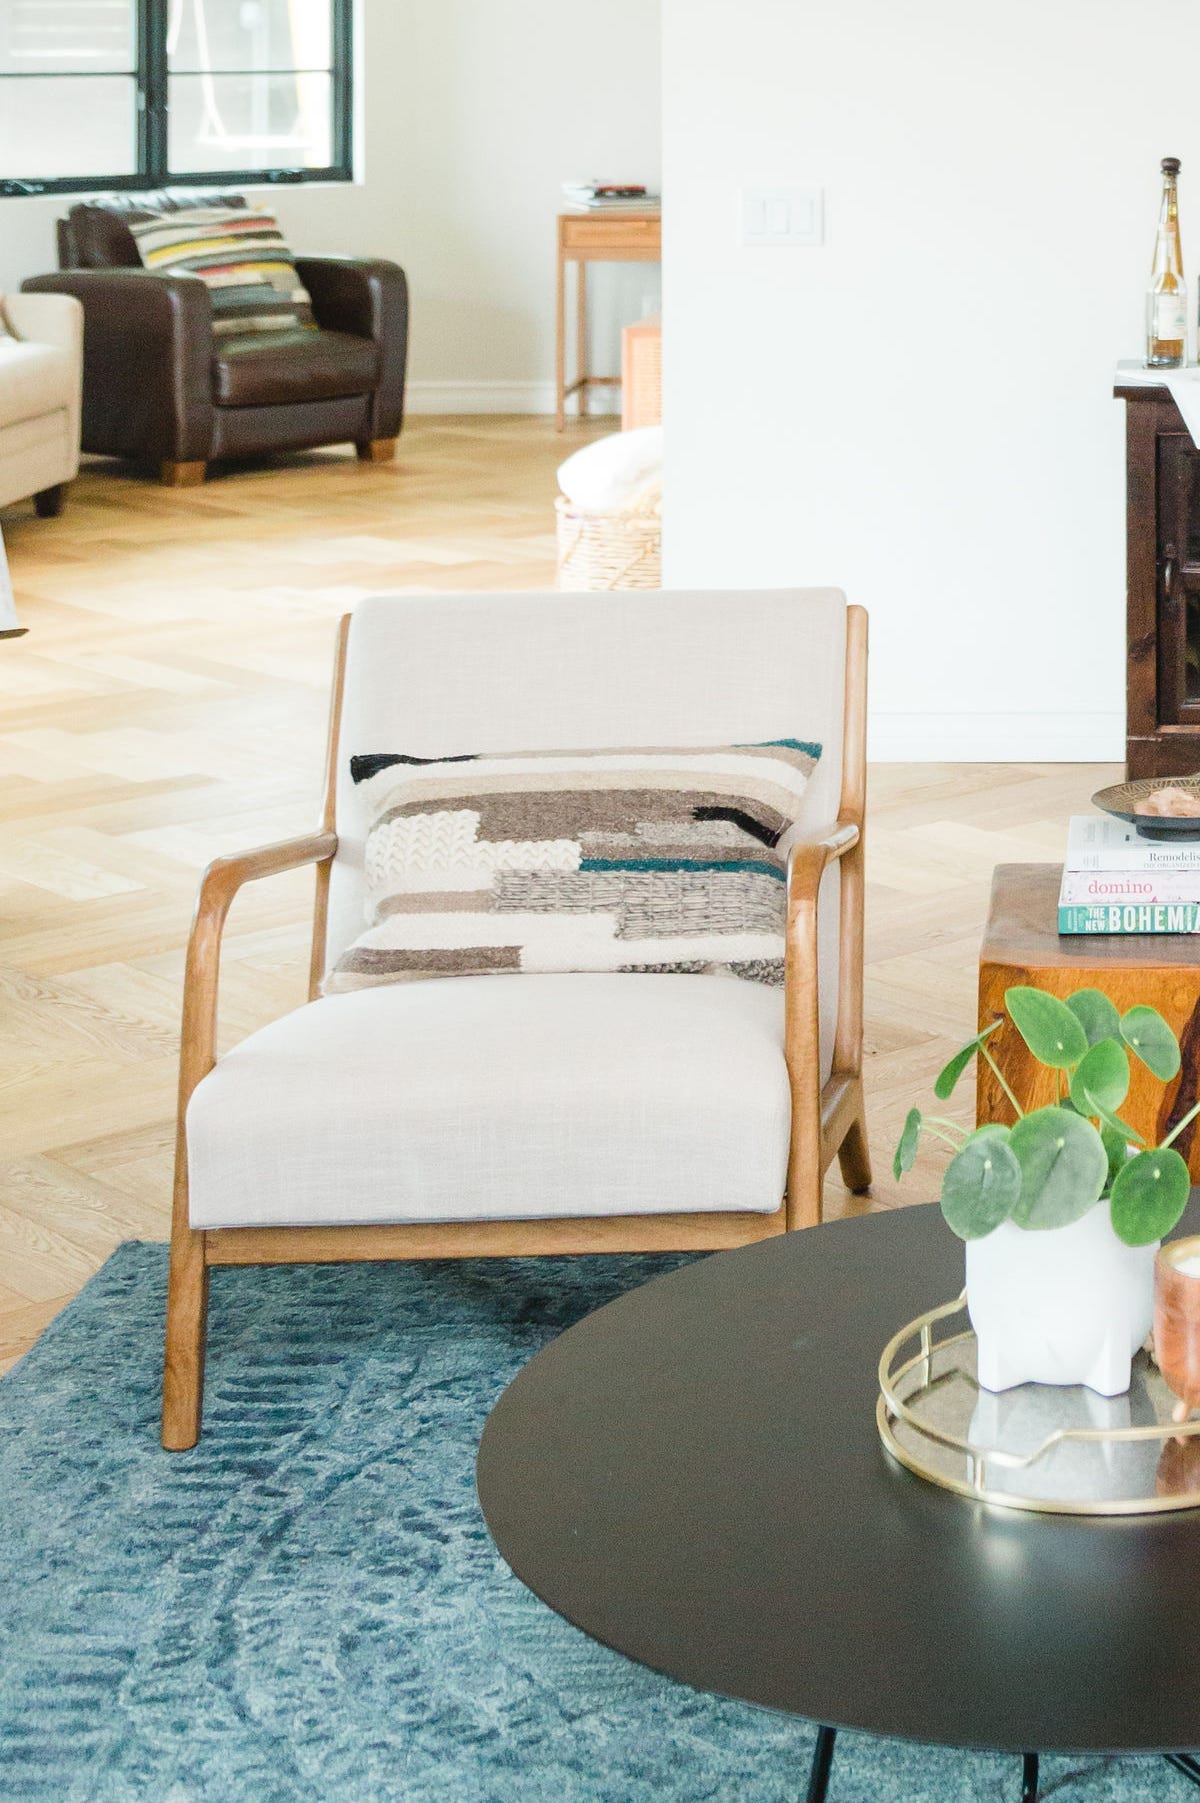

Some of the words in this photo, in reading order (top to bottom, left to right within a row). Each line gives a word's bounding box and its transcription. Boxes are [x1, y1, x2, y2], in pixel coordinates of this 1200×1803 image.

[1088, 879, 1153, 894] domino
[1089, 906, 1106, 919] THE
[1085, 920, 1107, 932] NEW
